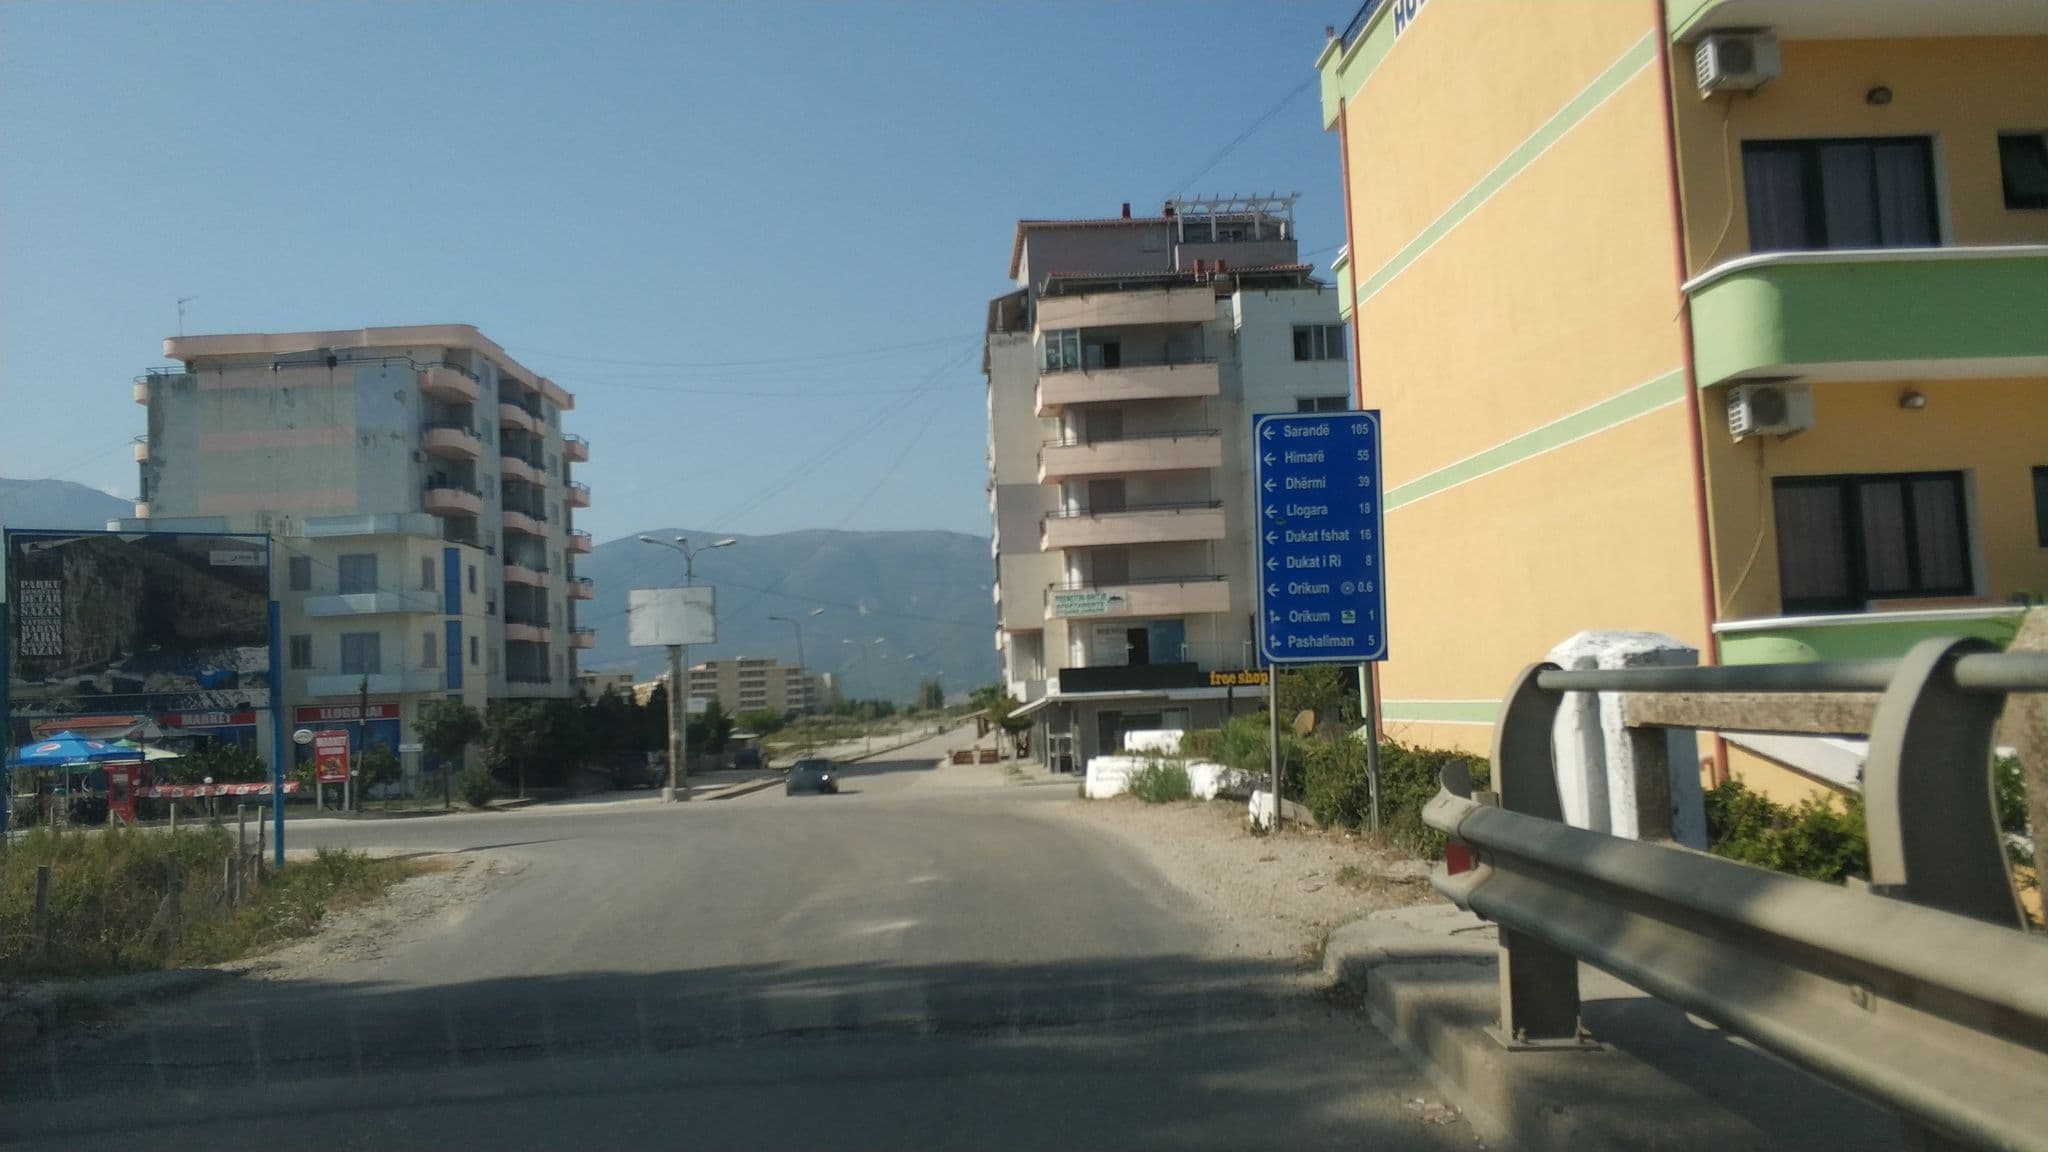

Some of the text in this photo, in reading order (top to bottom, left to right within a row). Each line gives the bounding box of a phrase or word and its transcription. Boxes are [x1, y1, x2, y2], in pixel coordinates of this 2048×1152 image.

[1284, 423, 1369, 438] Sarandë 105
[1285, 450, 1369, 464] Himarë 55
[1285, 475, 1370, 490] Dhërmi 39
[1286, 503, 1371, 519] Llogara 18
[1285, 529, 1371, 543] Dukat fshat 16
[1286, 555, 1372, 569] Dukat i Ri 8
[20, 580, 61, 589] PARKU
[1288, 581, 1373, 595] Orikum 0.6
[20, 607, 61, 617] SAZAN
[1289, 609, 1374, 623] Orikum 1
[21, 632, 62, 642] PARK
[1287, 634, 1375, 648] Pashaliman 5
[21, 646, 62, 656] SAZAN
[1237, 670, 1269, 686] shop
[181, 711, 231, 724] MARKET
